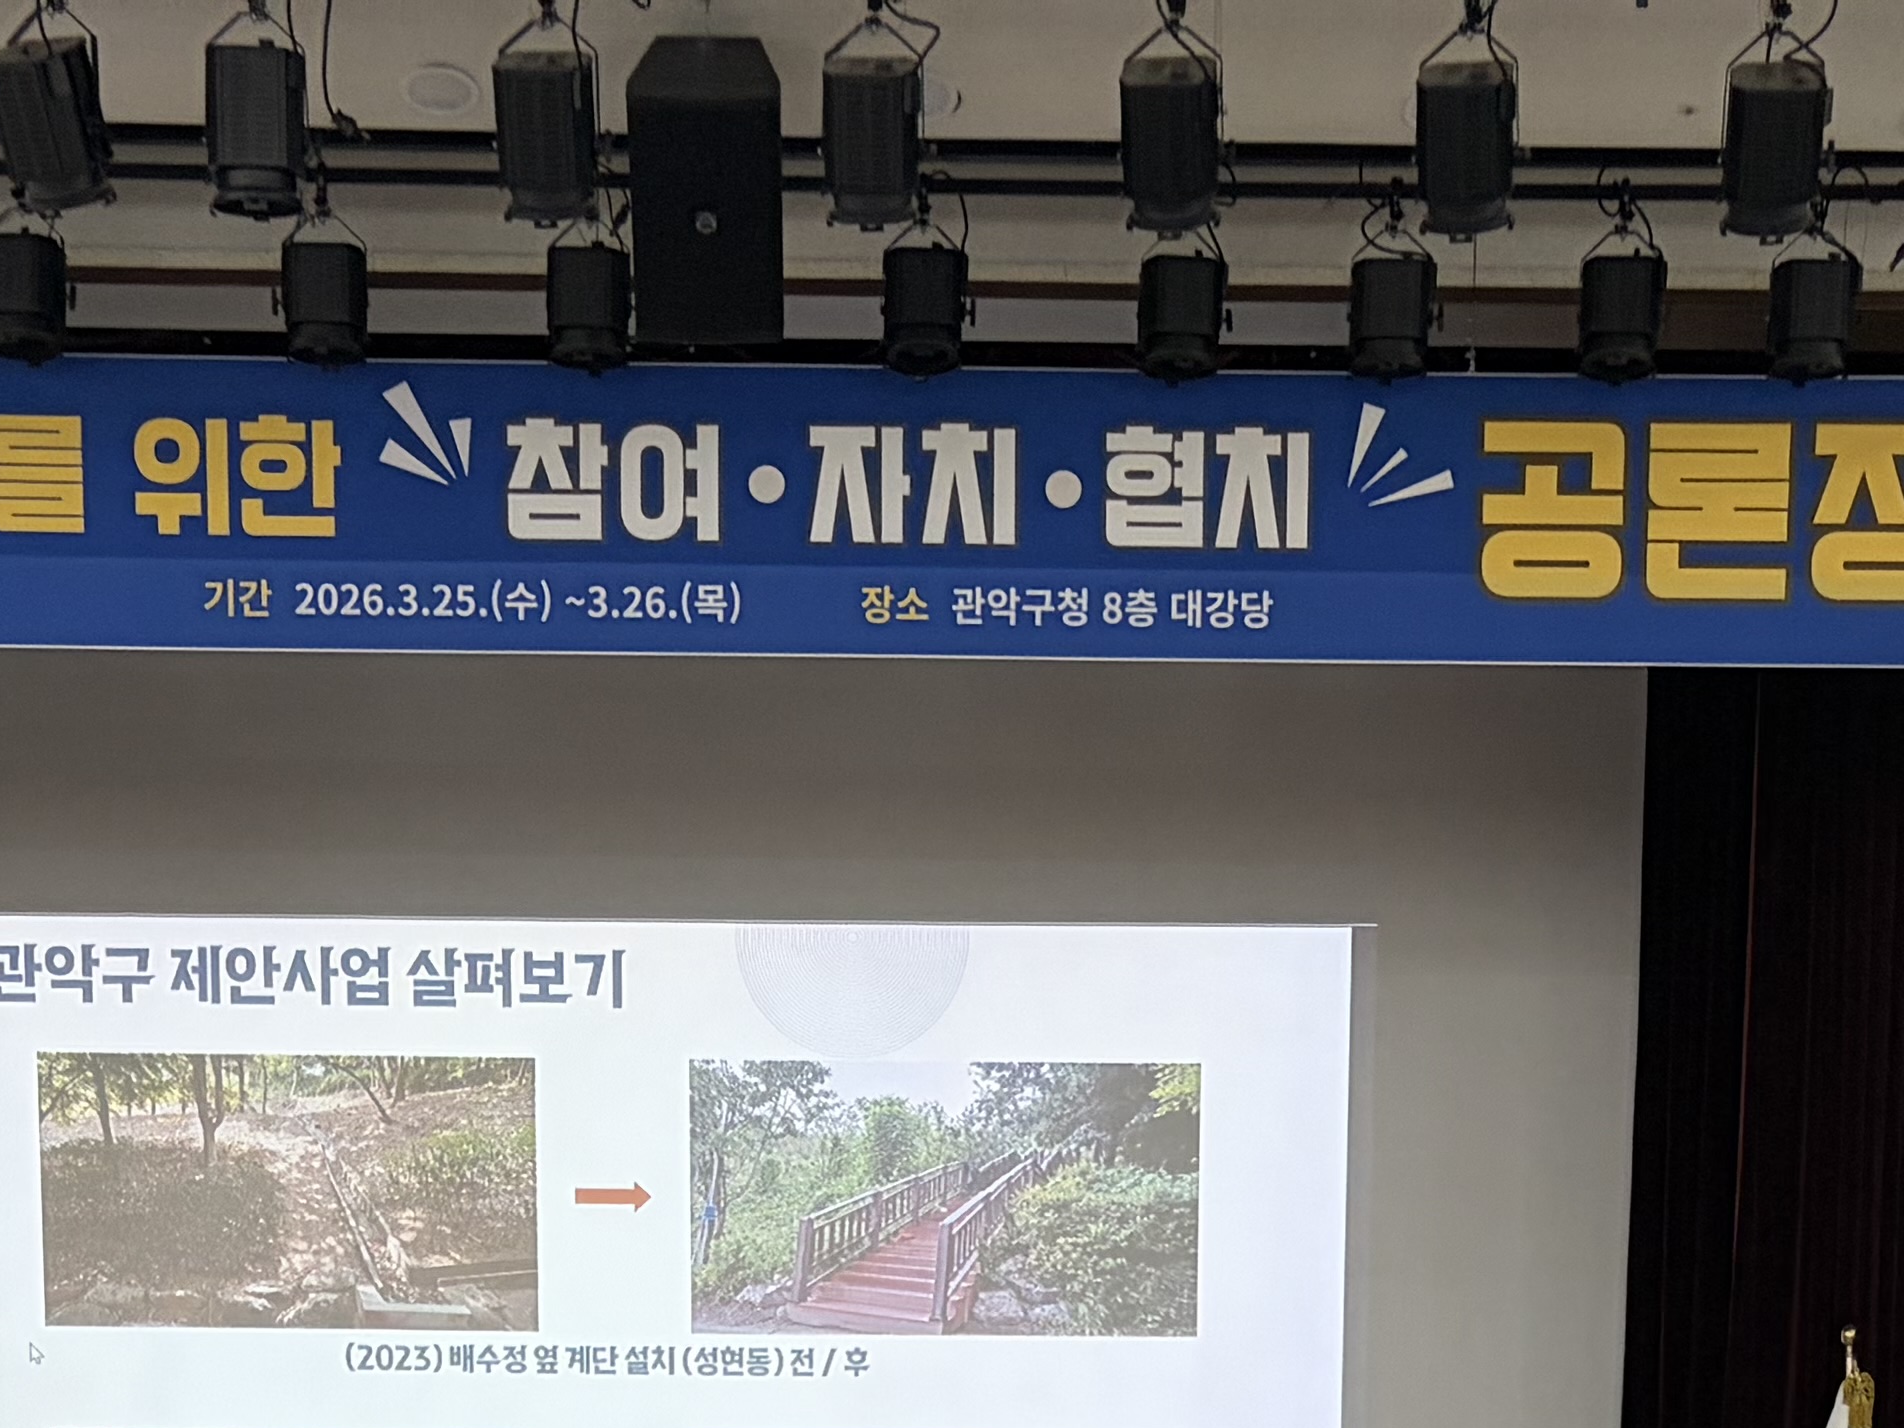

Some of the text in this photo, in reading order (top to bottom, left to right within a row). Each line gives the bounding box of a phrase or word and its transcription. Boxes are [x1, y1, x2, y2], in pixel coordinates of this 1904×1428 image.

[132, 413, 342, 538] 위한
[203, 578, 273, 619] 기간
[293, 578, 553, 625] 2026.3.25.(수)
[859, 584, 1275, 630] 장소 관악구청 8층 대강당
[169, 943, 392, 1006] 제안사업
[405, 947, 627, 1009] 살펴보기
[344, 1342, 444, 1375] (2023)
[448, 1343, 528, 1375] 배수정
[534, 1344, 559, 1376] 옆
[566, 1344, 619, 1376] 계단
[789, 1346, 815, 1377] 전
[842, 1347, 871, 1378] 후
